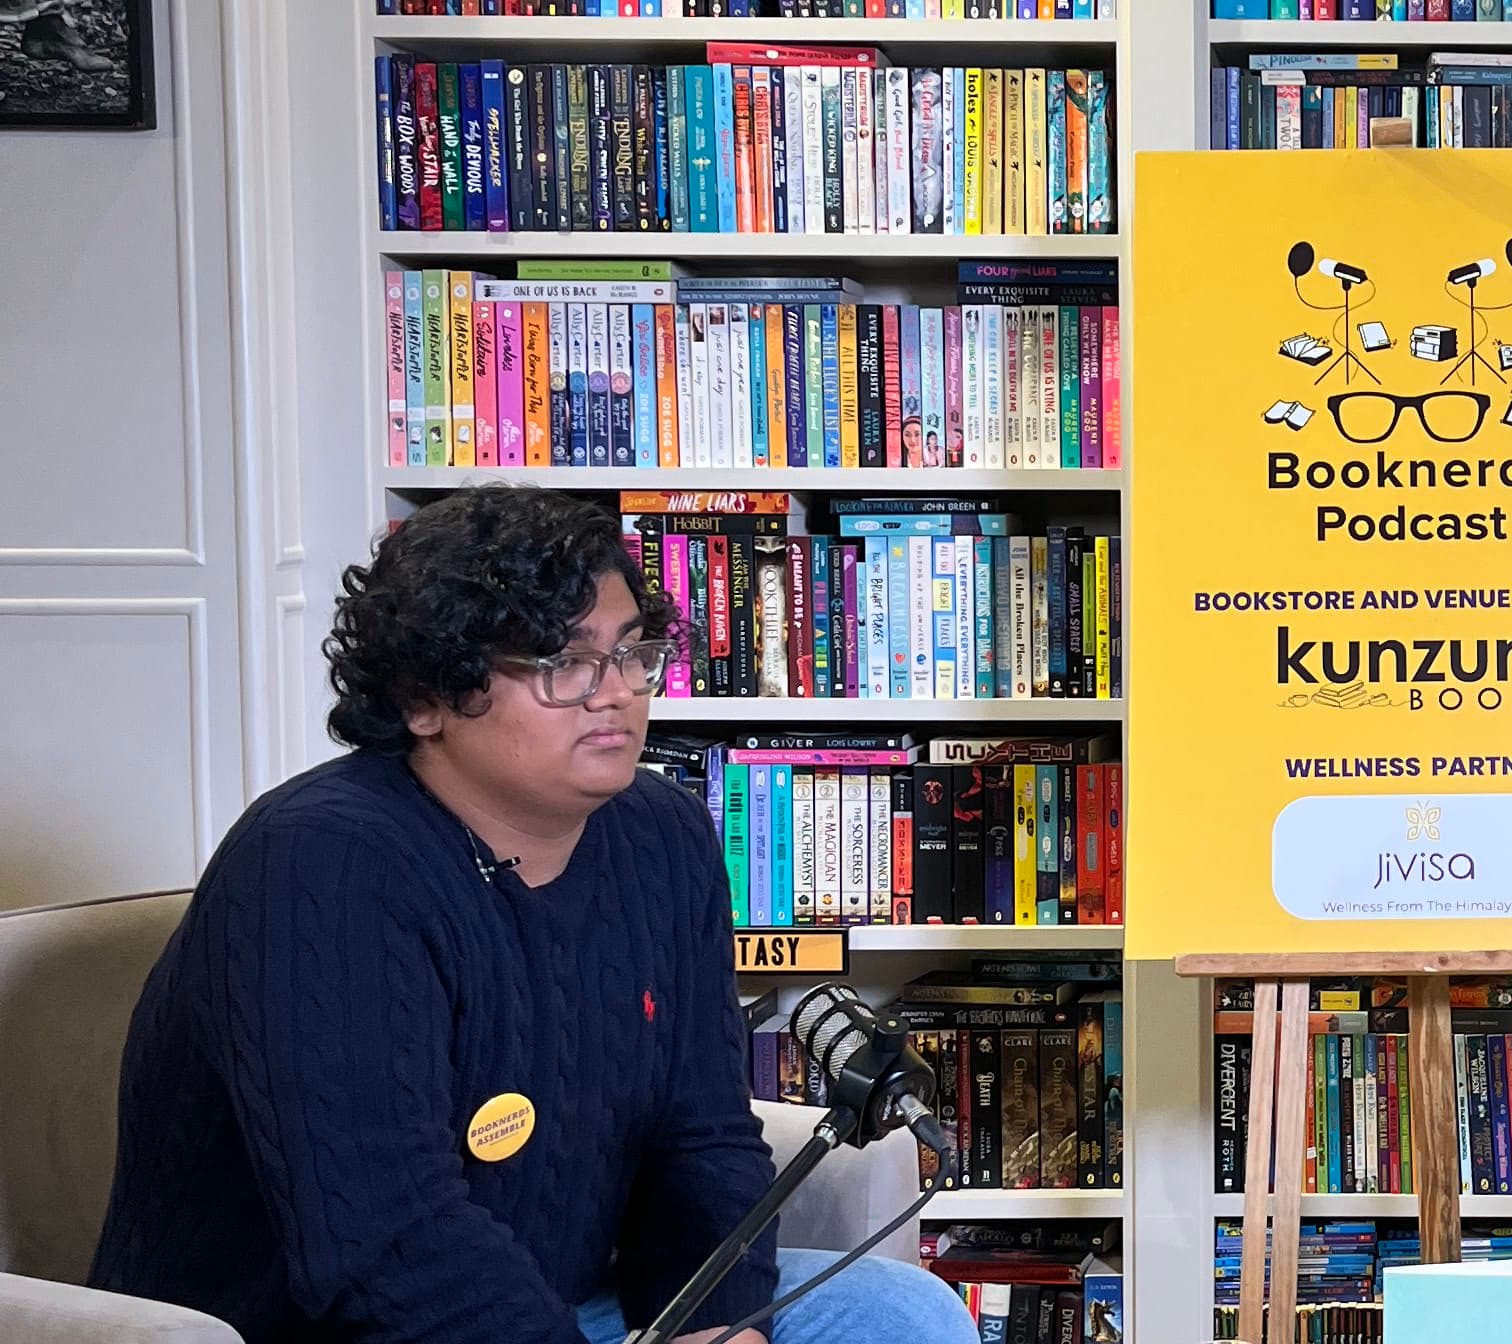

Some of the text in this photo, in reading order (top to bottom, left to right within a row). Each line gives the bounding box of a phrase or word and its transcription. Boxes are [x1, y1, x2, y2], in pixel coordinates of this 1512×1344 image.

[398, 116, 414, 144] BOX
[968, 74, 978, 167] holes LOUIS
[440, 116, 458, 194] HAND WALL
[572, 118, 588, 172] ENDLING
[613, 118, 632, 176] ENDLING
[400, 154, 416, 194] WOODS
[423, 150, 438, 187] STAIR
[466, 144, 482, 193] DEVIOUS
[513, 287, 531, 298] ONE
[534, 287, 546, 298] OF
[547, 287, 559, 298] US
[573, 287, 597, 298] BACK
[476, 322, 492, 377] Solitaire
[501, 324, 517, 372] Loveless
[550, 308, 564, 368] Ally Carter
[860, 338, 870, 373] THING
[868, 314, 879, 398] EVERY EXQUISITE
[528, 353, 540, 378] Born
[662, 396, 672, 446] ZOE SUGG
[667, 493, 747, 513] NINE LIARS
[921, 501, 976, 512] JOHN GREEN
[1316, 506, 1507, 541] Podcast
[644, 542, 658, 576] FIVE
[732, 542, 743, 608] MESSENGER
[1014, 565, 1025, 676] All the Broken Places
[1069, 582, 1081, 653] SMALL SPACES
[1194, 591, 1355, 612] BOOKSTORE
[1360, 590, 1418, 611] AND
[1428, 590, 1510, 610] VENUE
[770, 738, 814, 748] GIVER
[848, 739, 877, 748] LOWRY
[1285, 757, 1420, 778] WELLNESS
[802, 804, 812, 888] THE ALCHEMYST
[824, 805, 836, 882] THE MAGICIAN
[852, 808, 864, 885] THE SORCERESS
[878, 804, 888, 889] THE NECROMANCER
[1322, 900, 1384, 913] Wellness
[1387, 900, 1423, 912] From
[1427, 899, 1453, 911] The
[737, 937, 801, 967] TASY
[977, 1072, 994, 1106] DEATH
[1220, 1044, 1236, 1172] DIVERGENT ROTH
[470, 1106, 531, 1139] BOOKNERDS
[476, 1119, 527, 1147] ASSEMBLE
